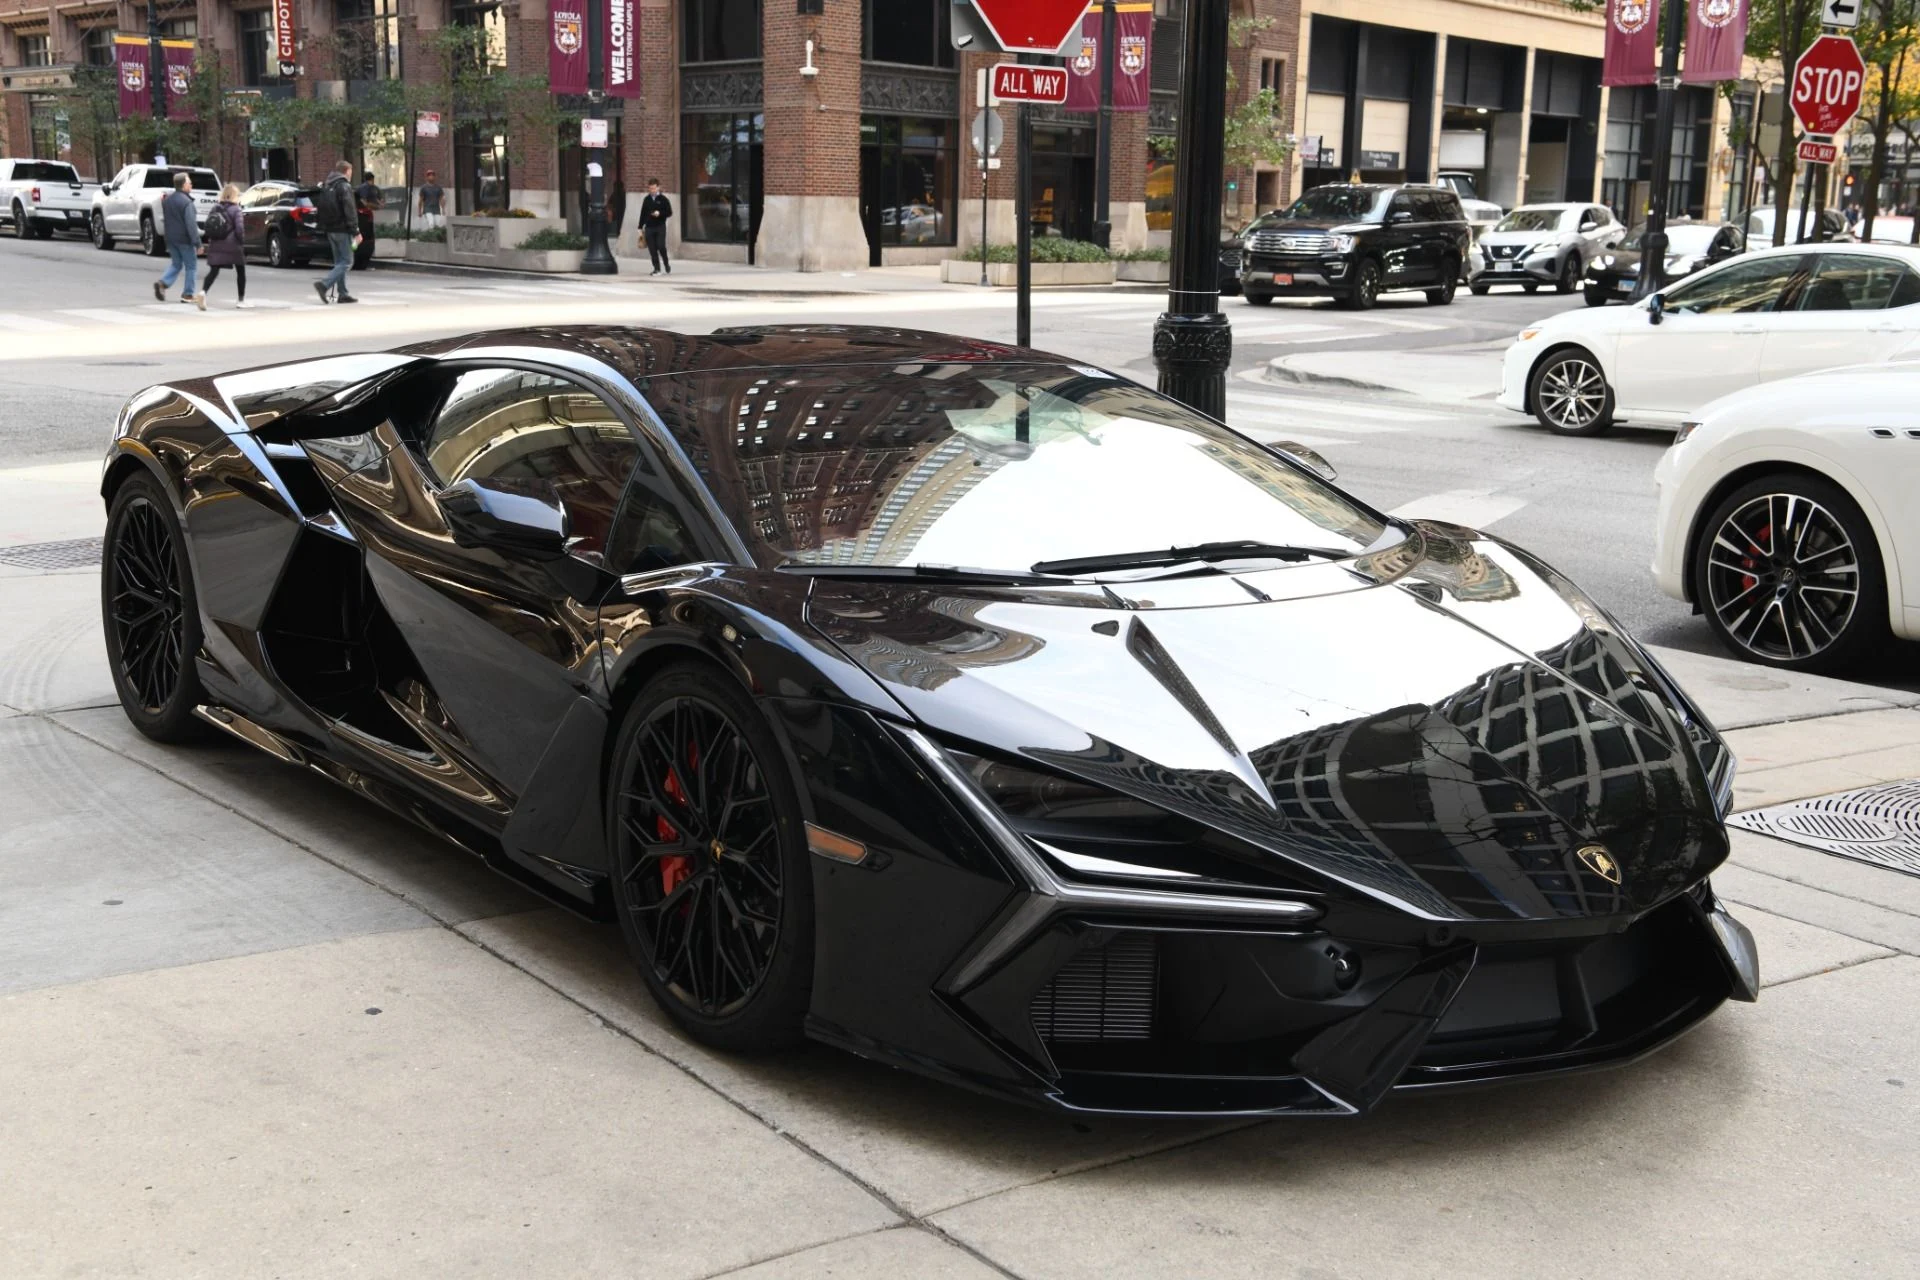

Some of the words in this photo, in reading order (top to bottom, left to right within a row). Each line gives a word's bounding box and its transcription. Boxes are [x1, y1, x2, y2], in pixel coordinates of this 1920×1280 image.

[554, 11, 581, 20] LOYOLA
[1001, 72, 1028, 94] ALL
[1033, 74, 1061, 96] WAY
[1796, 66, 1860, 106] STOP
[1801, 146, 1817, 158] ALL
[1819, 148, 1834, 160] WAY
